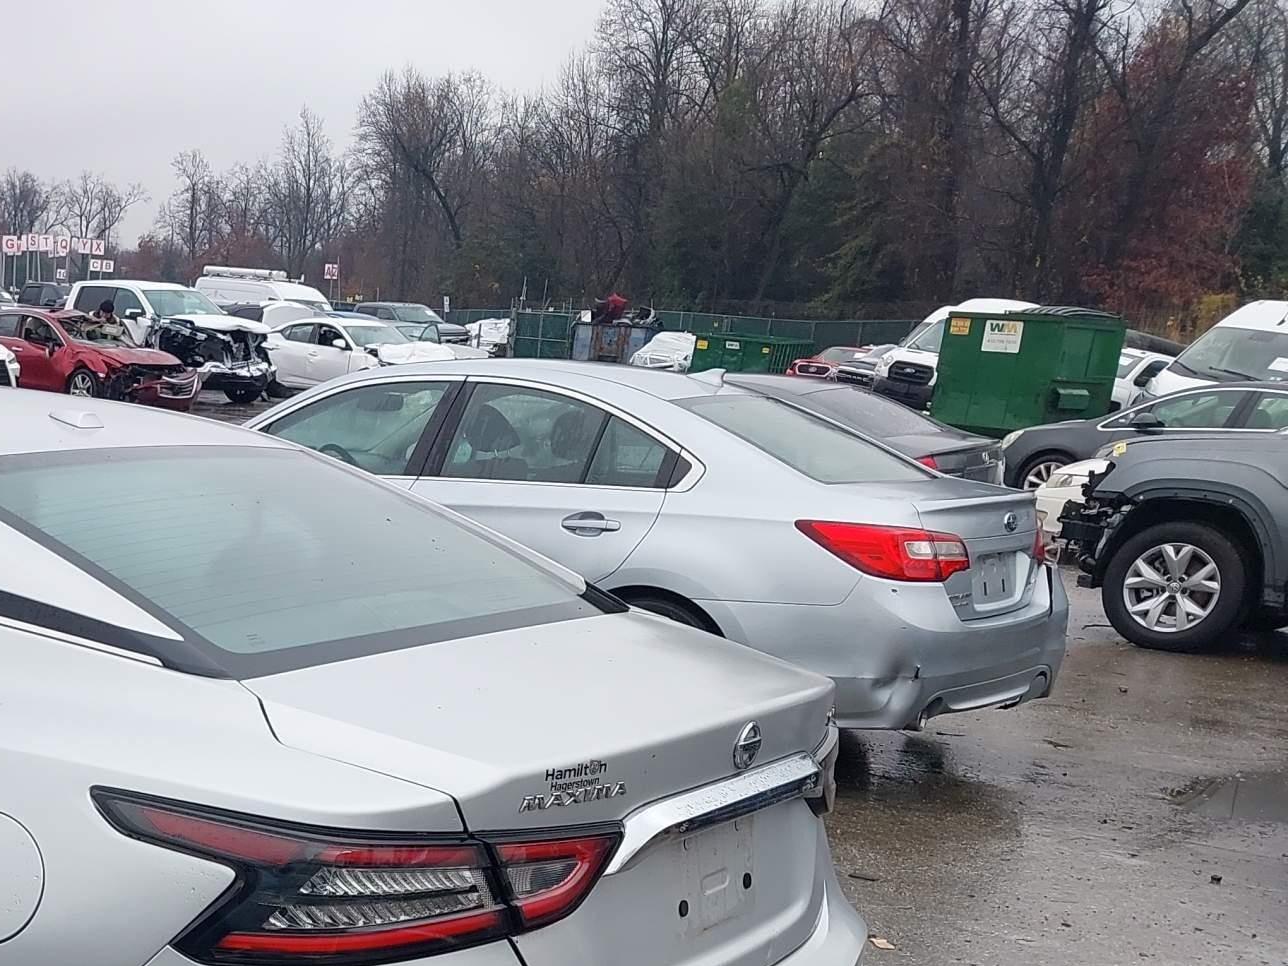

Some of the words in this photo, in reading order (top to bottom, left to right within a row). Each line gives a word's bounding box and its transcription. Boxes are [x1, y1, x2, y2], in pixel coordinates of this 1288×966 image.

[6, 238, 15, 249] G
[30, 235, 37, 246] S
[42, 236, 50, 247] T
[60, 239, 68, 250] Q
[81, 240, 89, 251] Y
[94, 241, 102, 253] X
[91, 261, 99, 269] C
[550, 777, 600, 793] Hagerstown
[519, 782, 626, 812] MAXIMA
